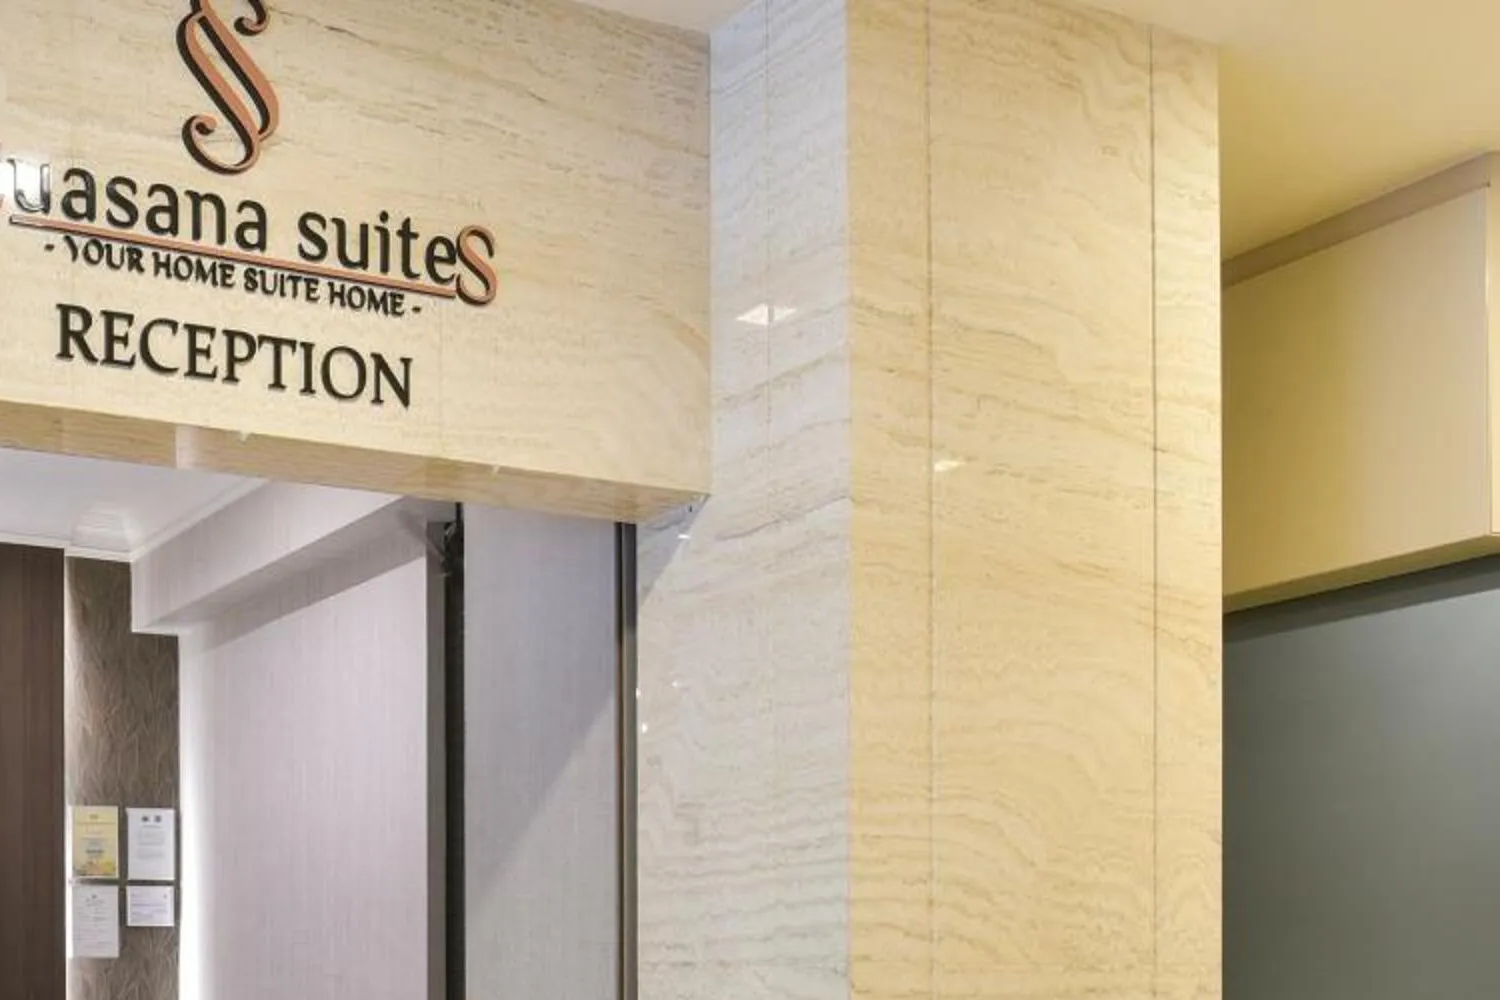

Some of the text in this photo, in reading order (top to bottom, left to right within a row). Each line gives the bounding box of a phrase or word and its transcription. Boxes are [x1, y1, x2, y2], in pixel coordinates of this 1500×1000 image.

[63, 234, 145, 275] YOUR
[152, 250, 236, 289] HOME
[243, 266, 320, 303] SUITE
[327, 280, 405, 318] HOME
[55, 302, 413, 408] RECEPTION
